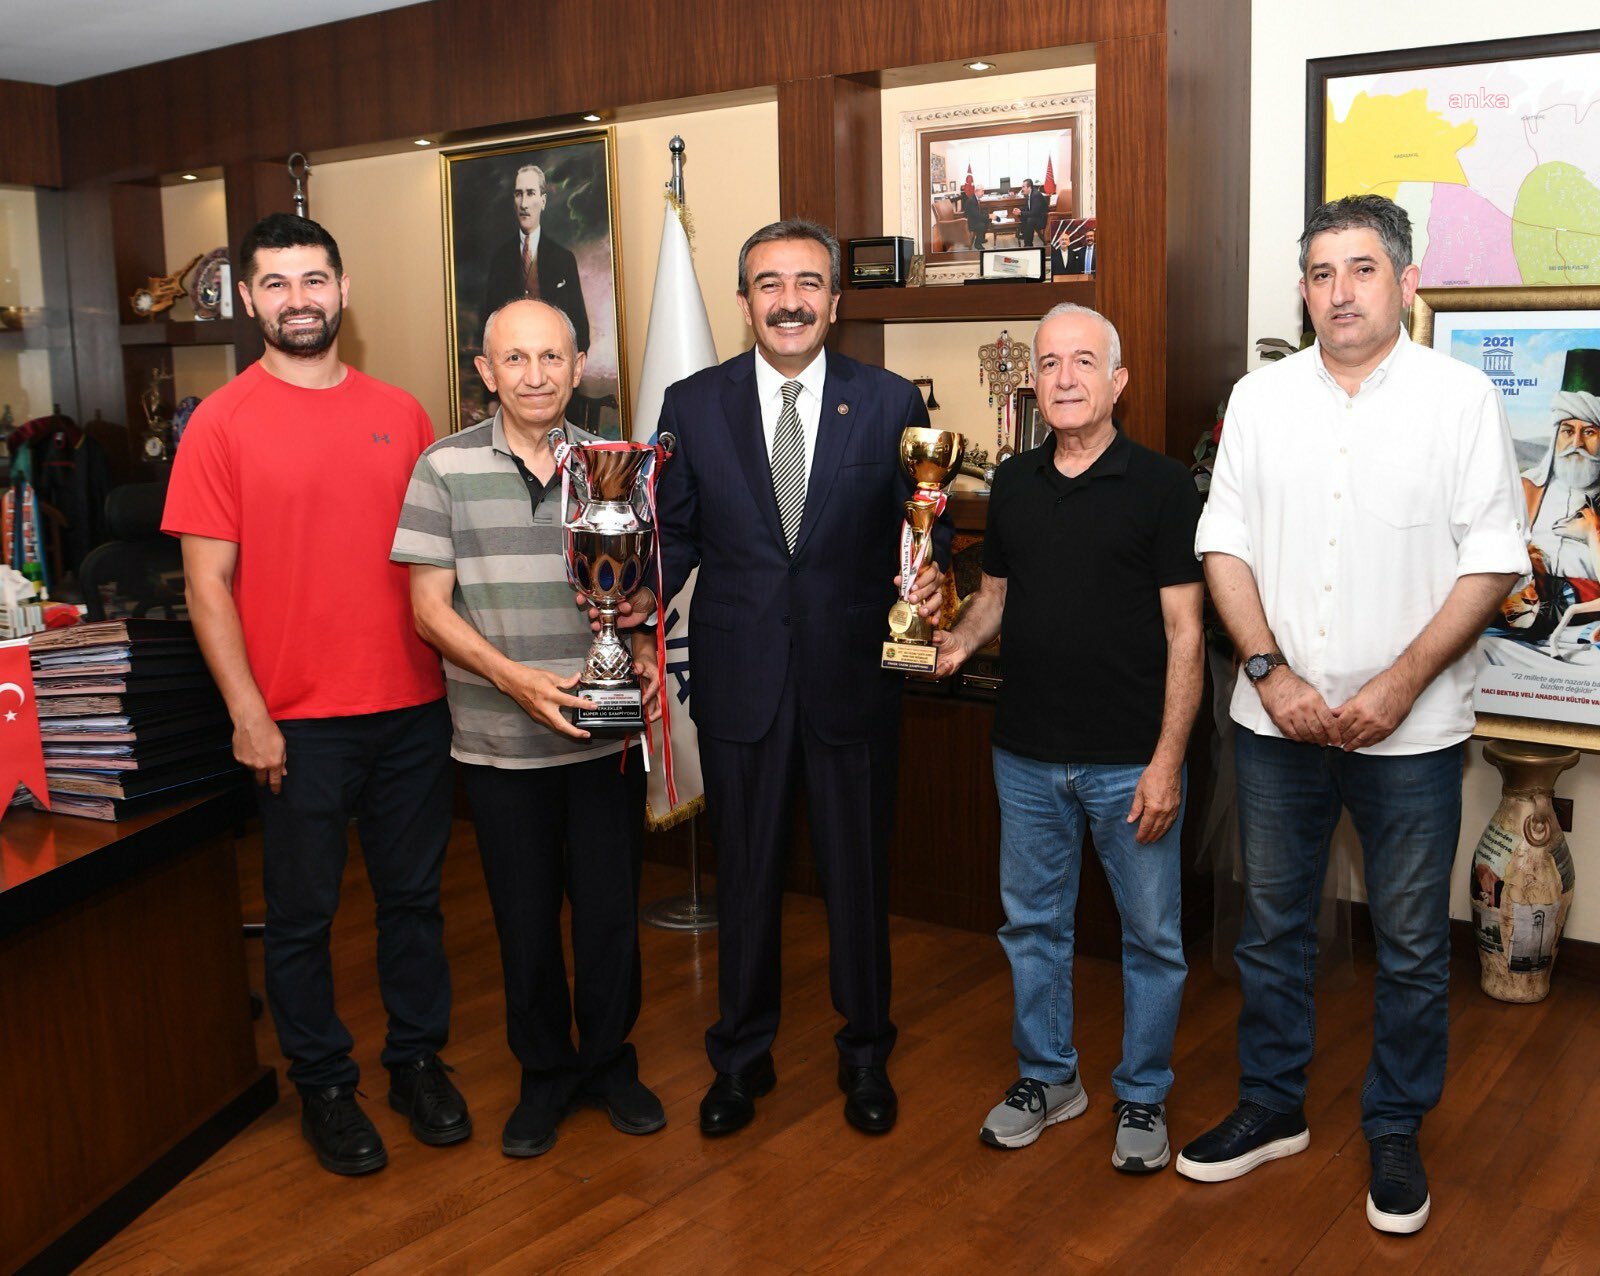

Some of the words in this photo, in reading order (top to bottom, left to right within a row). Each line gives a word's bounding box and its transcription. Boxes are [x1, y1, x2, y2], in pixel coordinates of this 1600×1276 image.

[1483, 336, 1514, 347] 2021
[1517, 378, 1537, 386] VELİ
[1541, 683, 1564, 691] bizden
[1536, 693, 1565, 701] ANADOLU
[1566, 696, 1590, 704] KÜLTÜR
